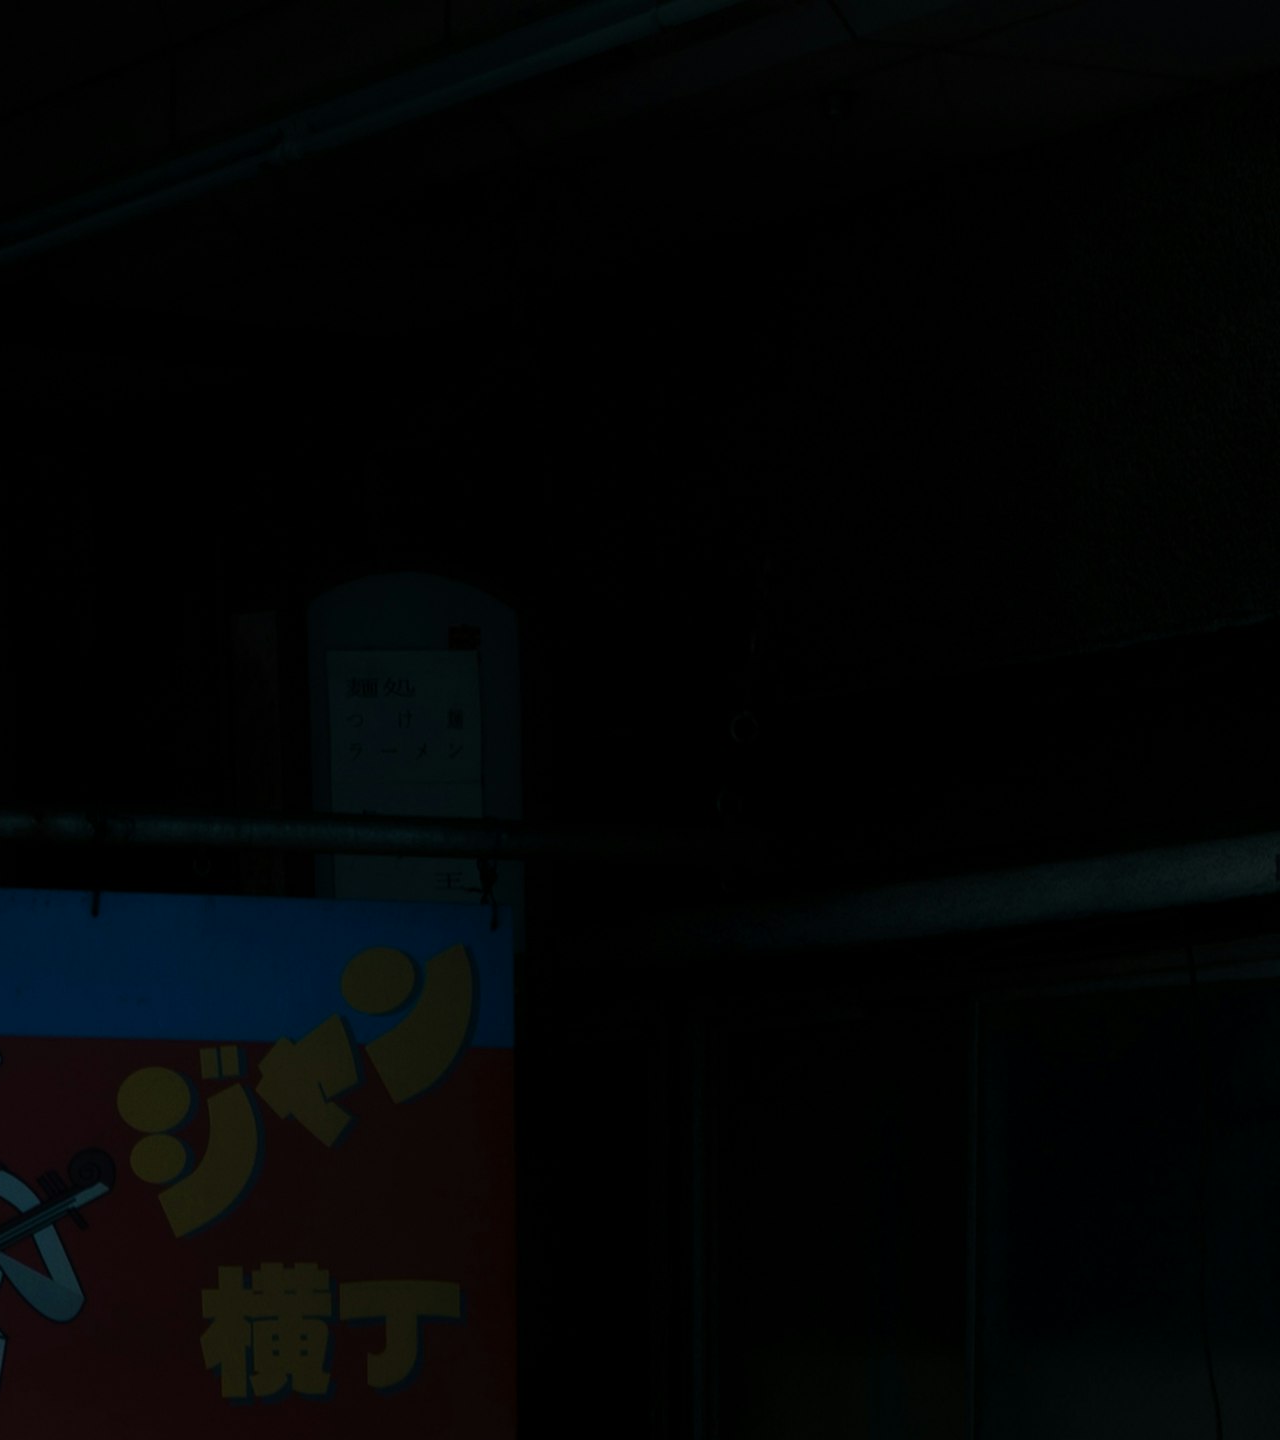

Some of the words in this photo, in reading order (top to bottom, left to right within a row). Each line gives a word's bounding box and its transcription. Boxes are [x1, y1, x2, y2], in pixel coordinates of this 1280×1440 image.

[116, 941, 480, 1240] ジャン
[199, 1260, 467, 1404] 横丁
